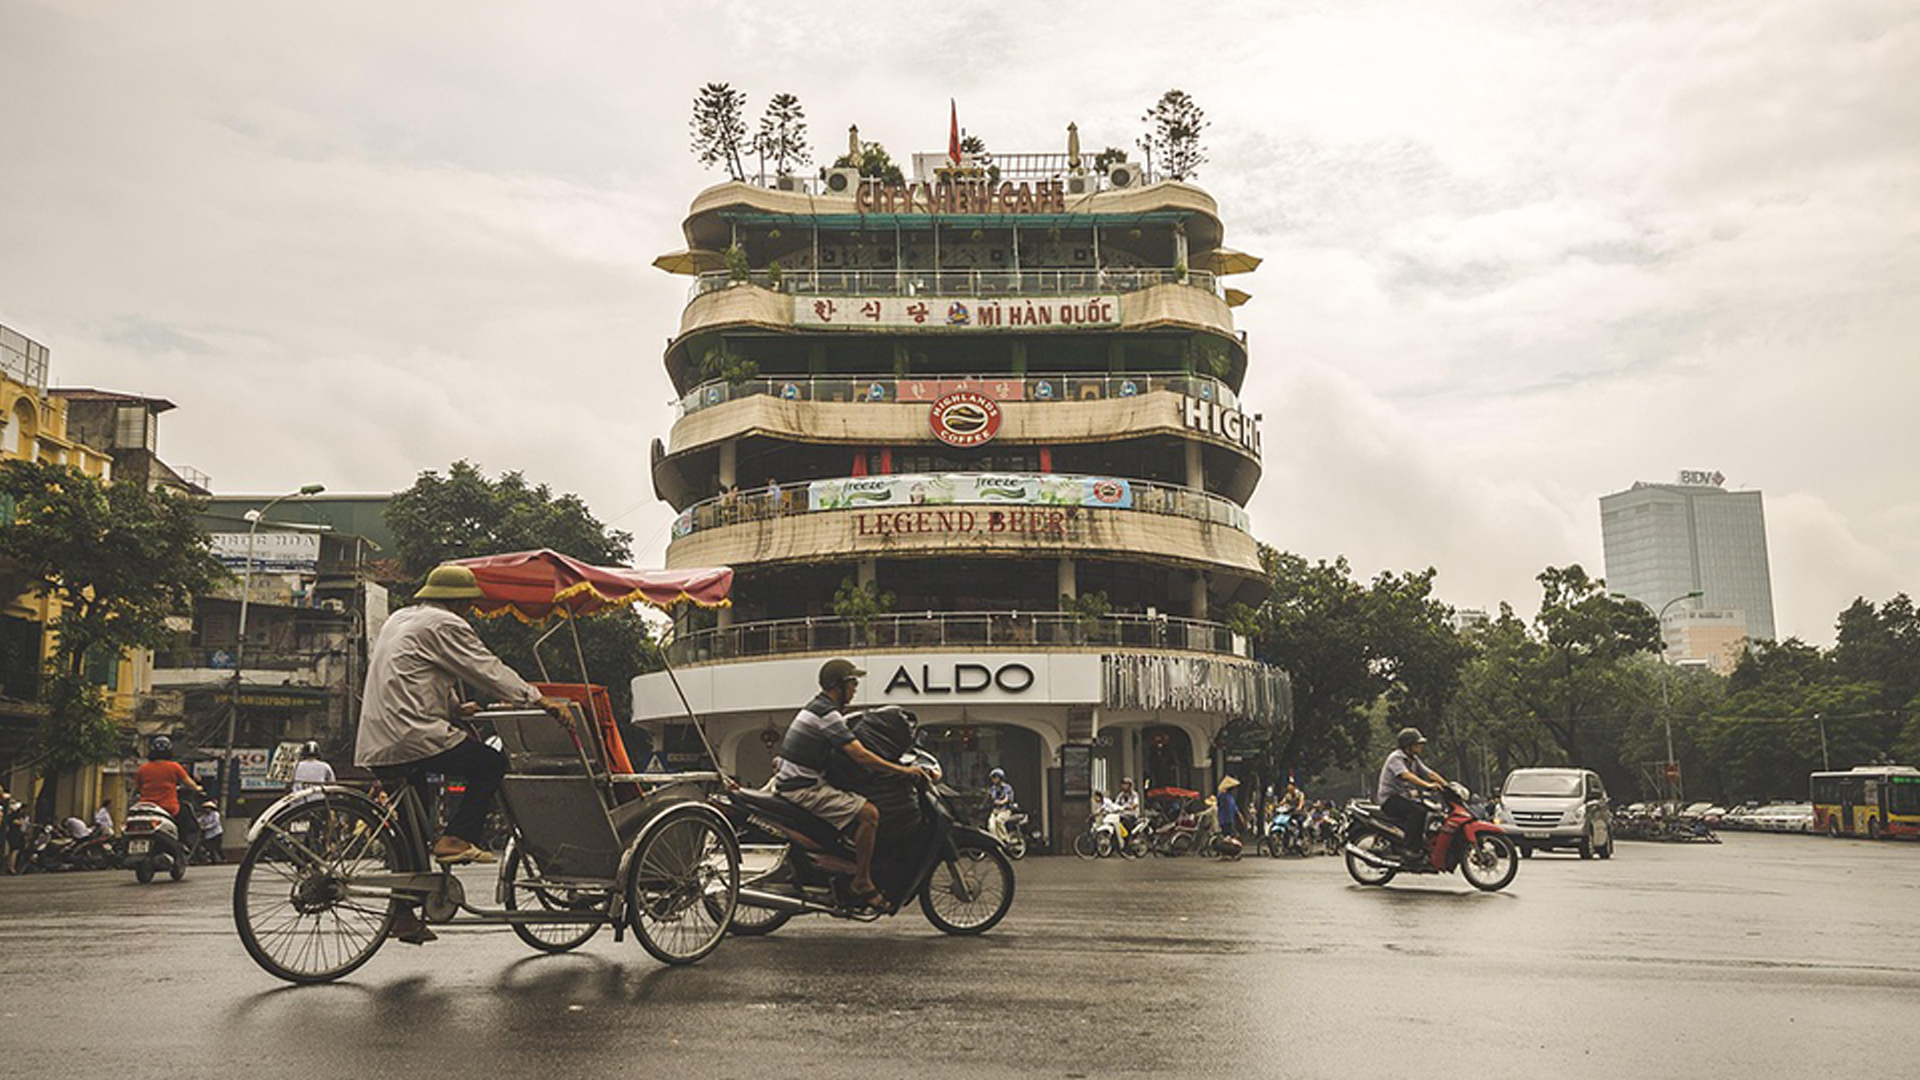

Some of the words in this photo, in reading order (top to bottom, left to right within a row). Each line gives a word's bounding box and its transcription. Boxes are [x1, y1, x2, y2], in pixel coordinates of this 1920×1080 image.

[857, 181, 917, 213] CITY
[924, 181, 993, 213] VIEW
[977, 301, 1001, 325] MÌ
[1009, 300, 1052, 325] HÀN
[1060, 298, 1112, 324] QUỐC
[933, 393, 998, 417] HIGHLANDS
[940, 430, 990, 443] COFFEE
[1681, 470, 1712, 484] BIDV
[858, 511, 975, 536] LEGEND
[988, 511, 1067, 536] BEER
[884, 664, 1034, 693] ALDO
